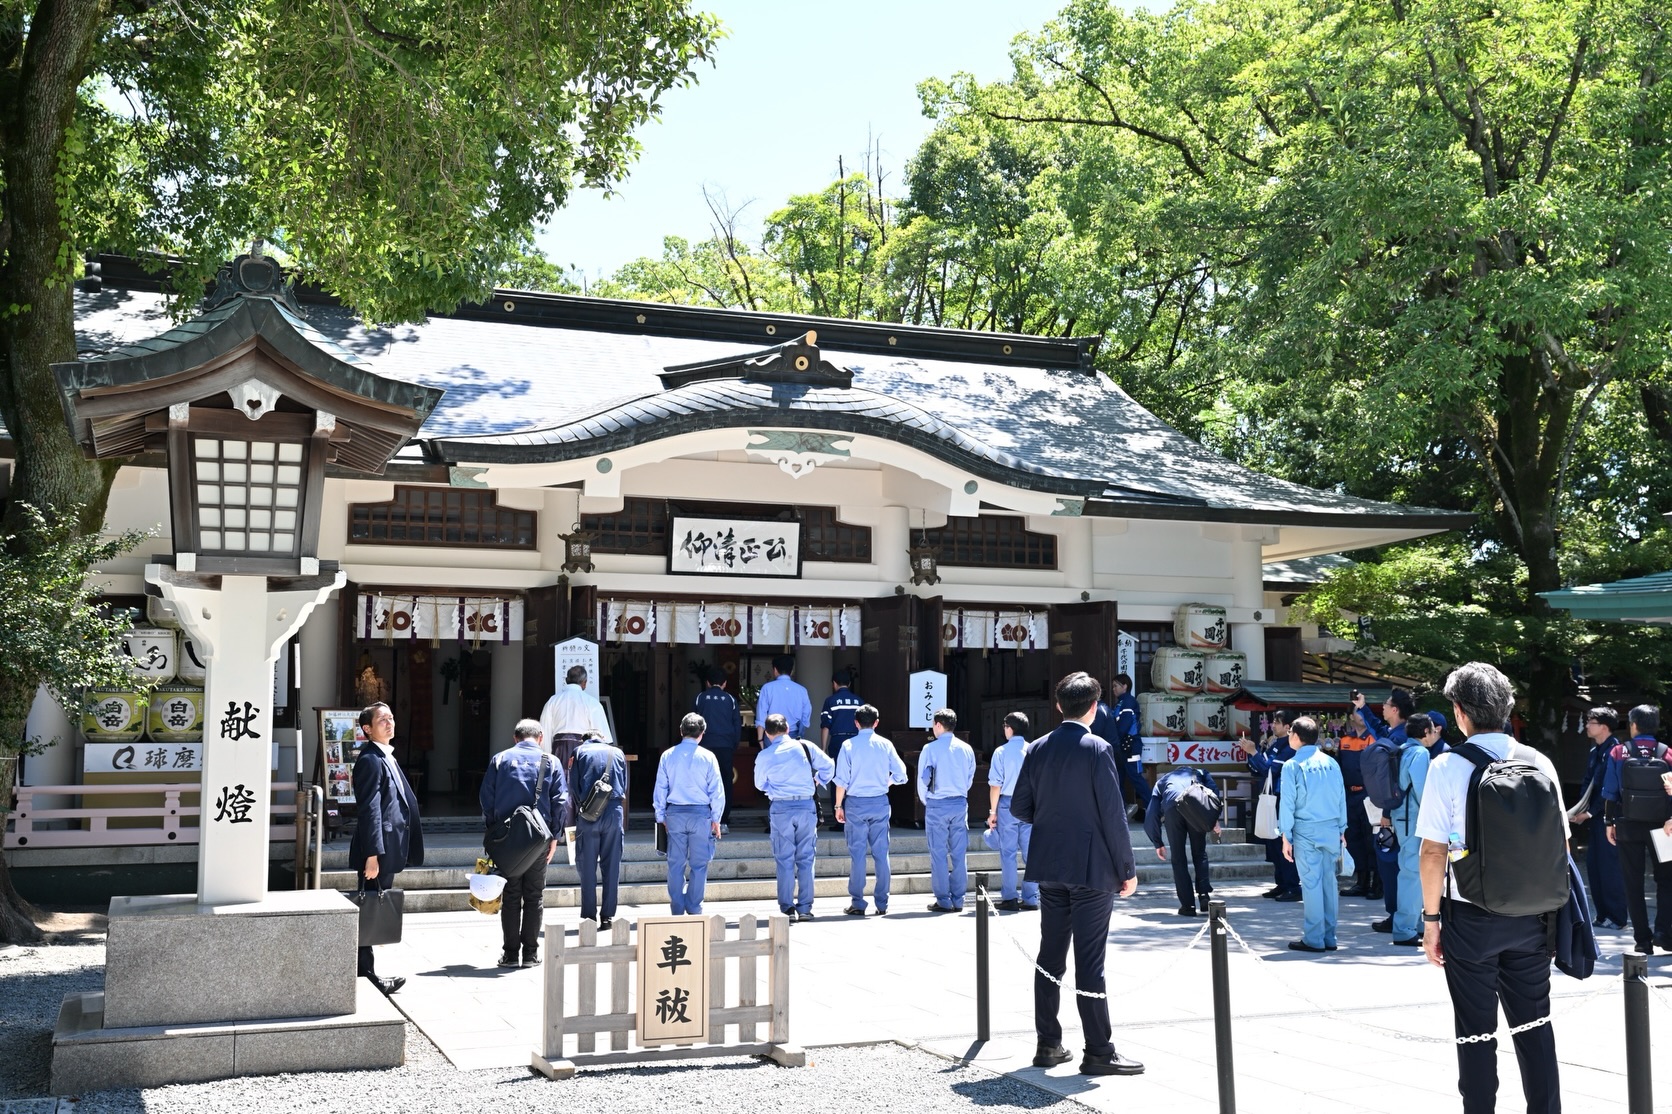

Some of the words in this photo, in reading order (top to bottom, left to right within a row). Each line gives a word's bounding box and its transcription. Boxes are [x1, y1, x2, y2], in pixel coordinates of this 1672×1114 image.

[168, 701, 188, 727] 白岳
[924, 681, 933, 721] おみくじ
[144, 747, 203, 769] 球磨
[214, 701, 261, 824] 献燈
[655, 935, 692, 1024] 車祓
